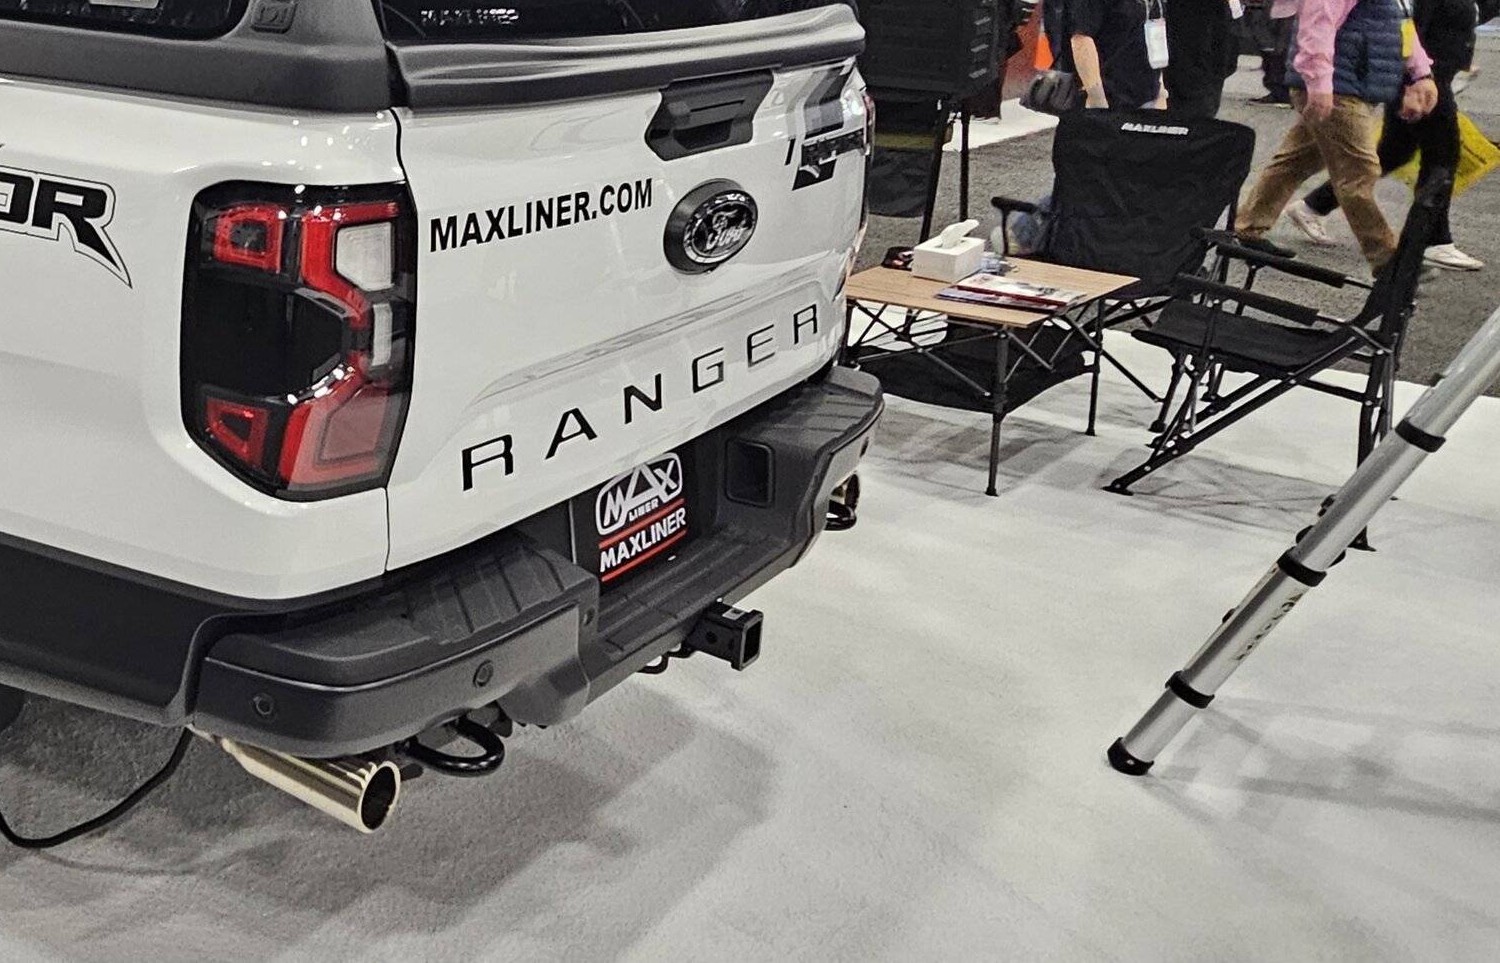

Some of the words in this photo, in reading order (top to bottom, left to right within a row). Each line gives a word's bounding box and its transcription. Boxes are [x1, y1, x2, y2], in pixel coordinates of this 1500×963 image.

[430, 178, 653, 252] MAXLINER.COM
[461, 304, 819, 491] RANGER
[600, 507, 687, 573] MAXLINER
